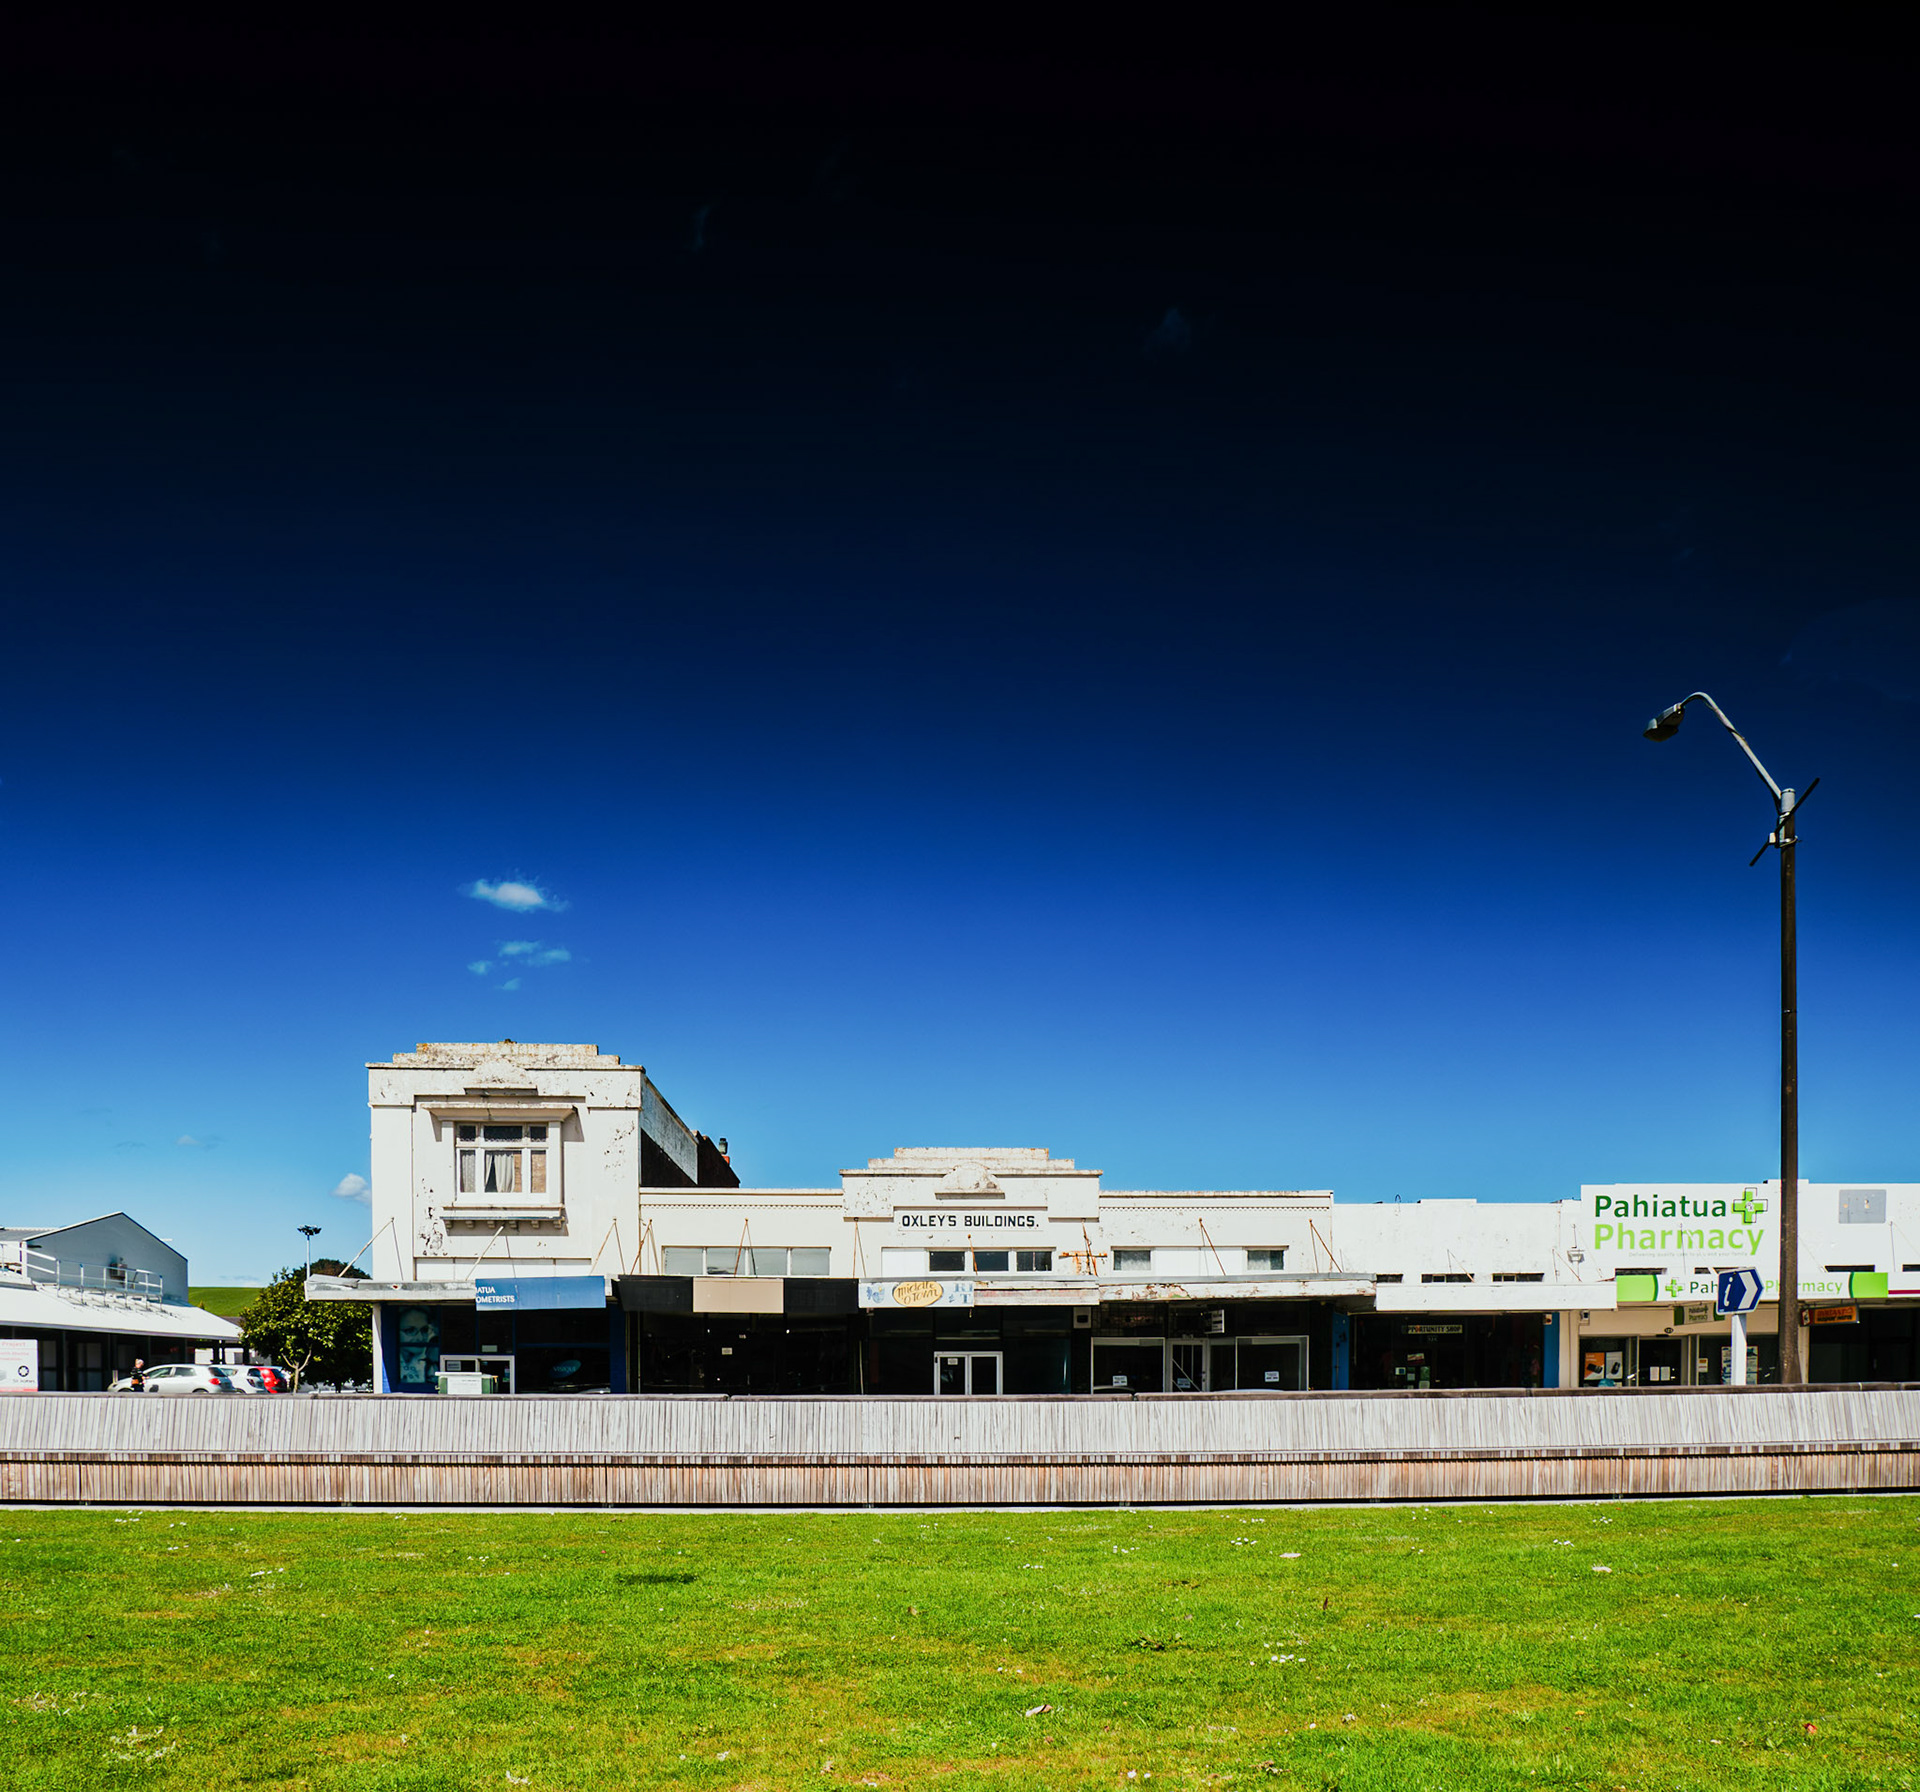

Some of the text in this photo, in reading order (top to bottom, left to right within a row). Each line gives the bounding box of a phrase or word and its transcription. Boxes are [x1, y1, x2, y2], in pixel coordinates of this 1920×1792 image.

[1595, 1194, 1727, 1217] Pahiatua
[901, 1215, 1039, 1227] OXLEY'S BUILDINGS.
[1594, 1222, 1764, 1255] Pharmacy
